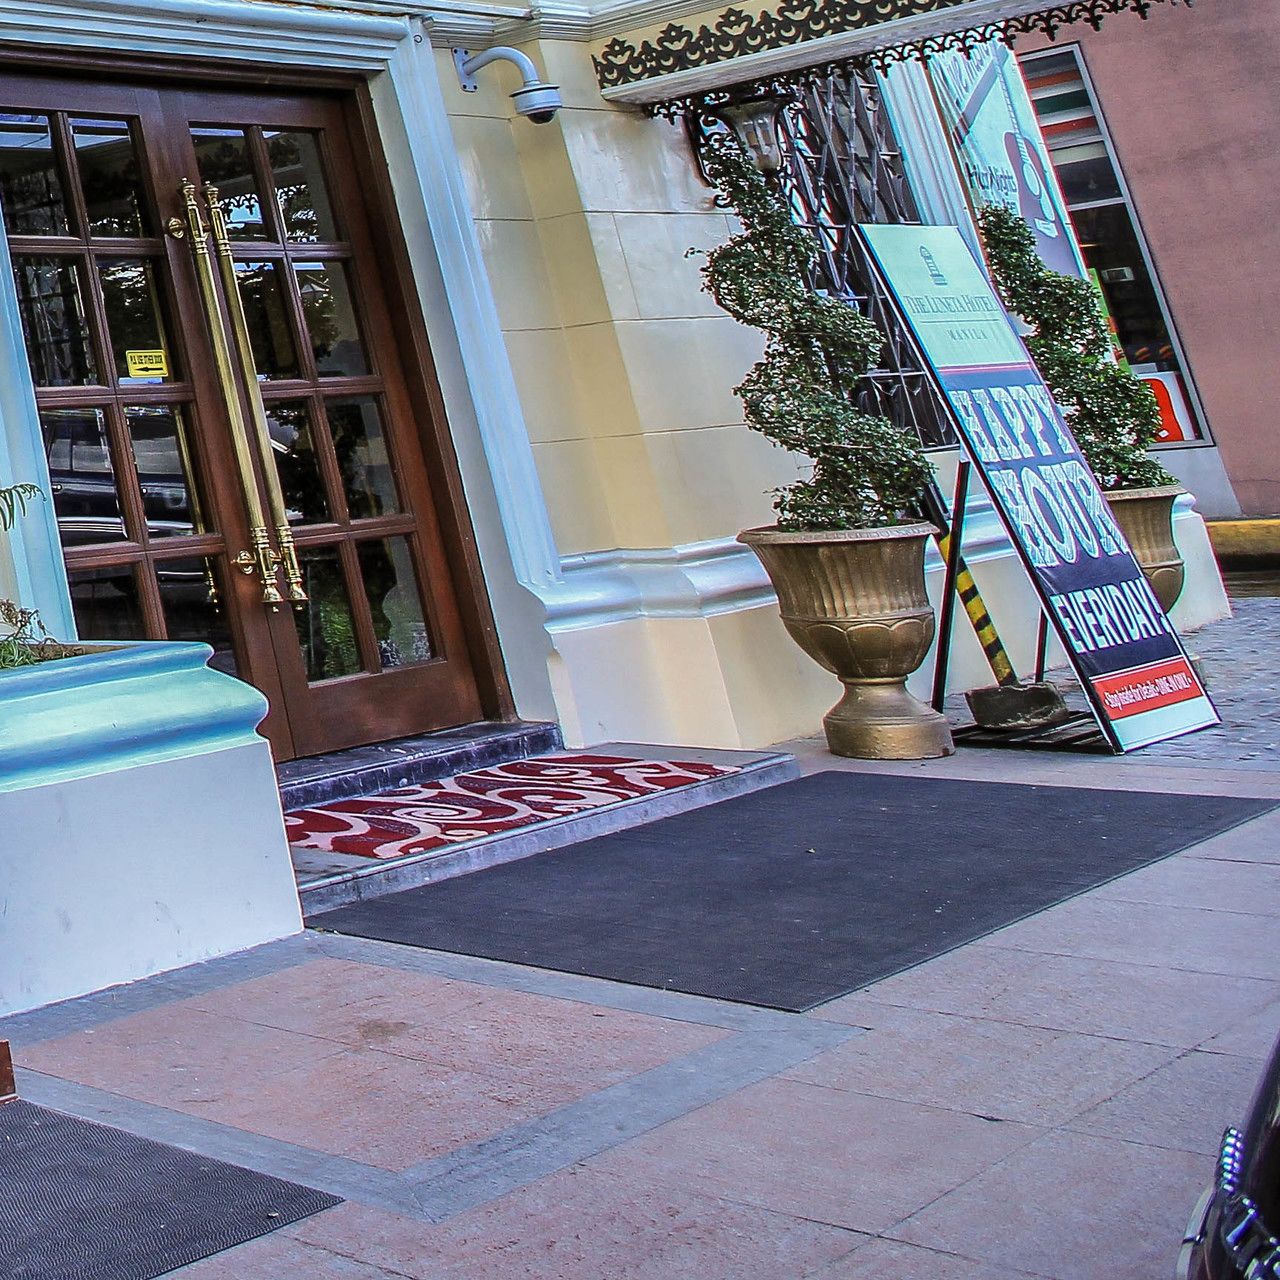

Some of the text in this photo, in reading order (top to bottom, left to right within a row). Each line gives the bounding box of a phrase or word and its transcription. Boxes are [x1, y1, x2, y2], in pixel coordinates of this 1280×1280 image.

[903, 294, 999, 313] THE LUNETA HOTEL
[948, 384, 1074, 462] HAPPY
[988, 461, 1129, 568] HOUR
